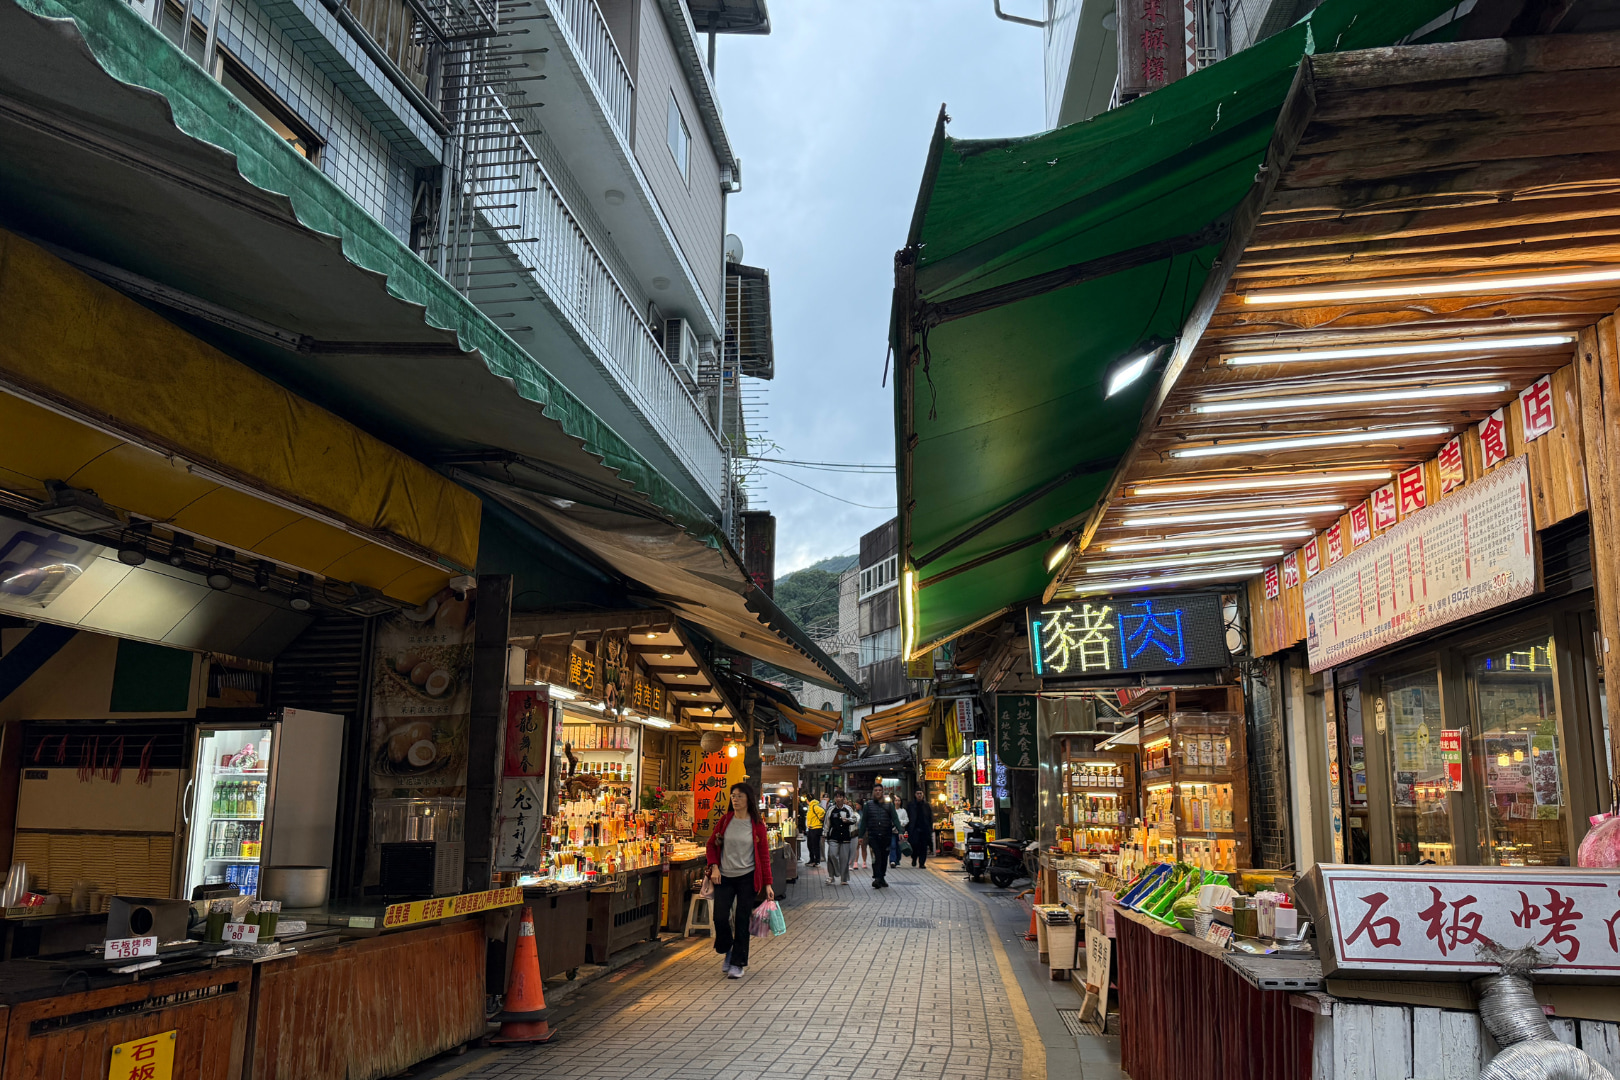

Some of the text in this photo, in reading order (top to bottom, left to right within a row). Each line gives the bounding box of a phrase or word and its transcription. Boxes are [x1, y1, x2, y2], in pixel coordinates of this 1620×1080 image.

[569, 653, 595, 690] 麗芳
[1016, 697, 1033, 767] 山地美食屋
[227, 924, 256, 934] 竹筒飯
[231, 932, 242, 940] 80
[1345, 885, 1620, 963] 石板烤
[110, 938, 152, 950] 石板烤肉
[117, 948, 139, 958] 150
[128, 1040, 158, 1080] 石板
